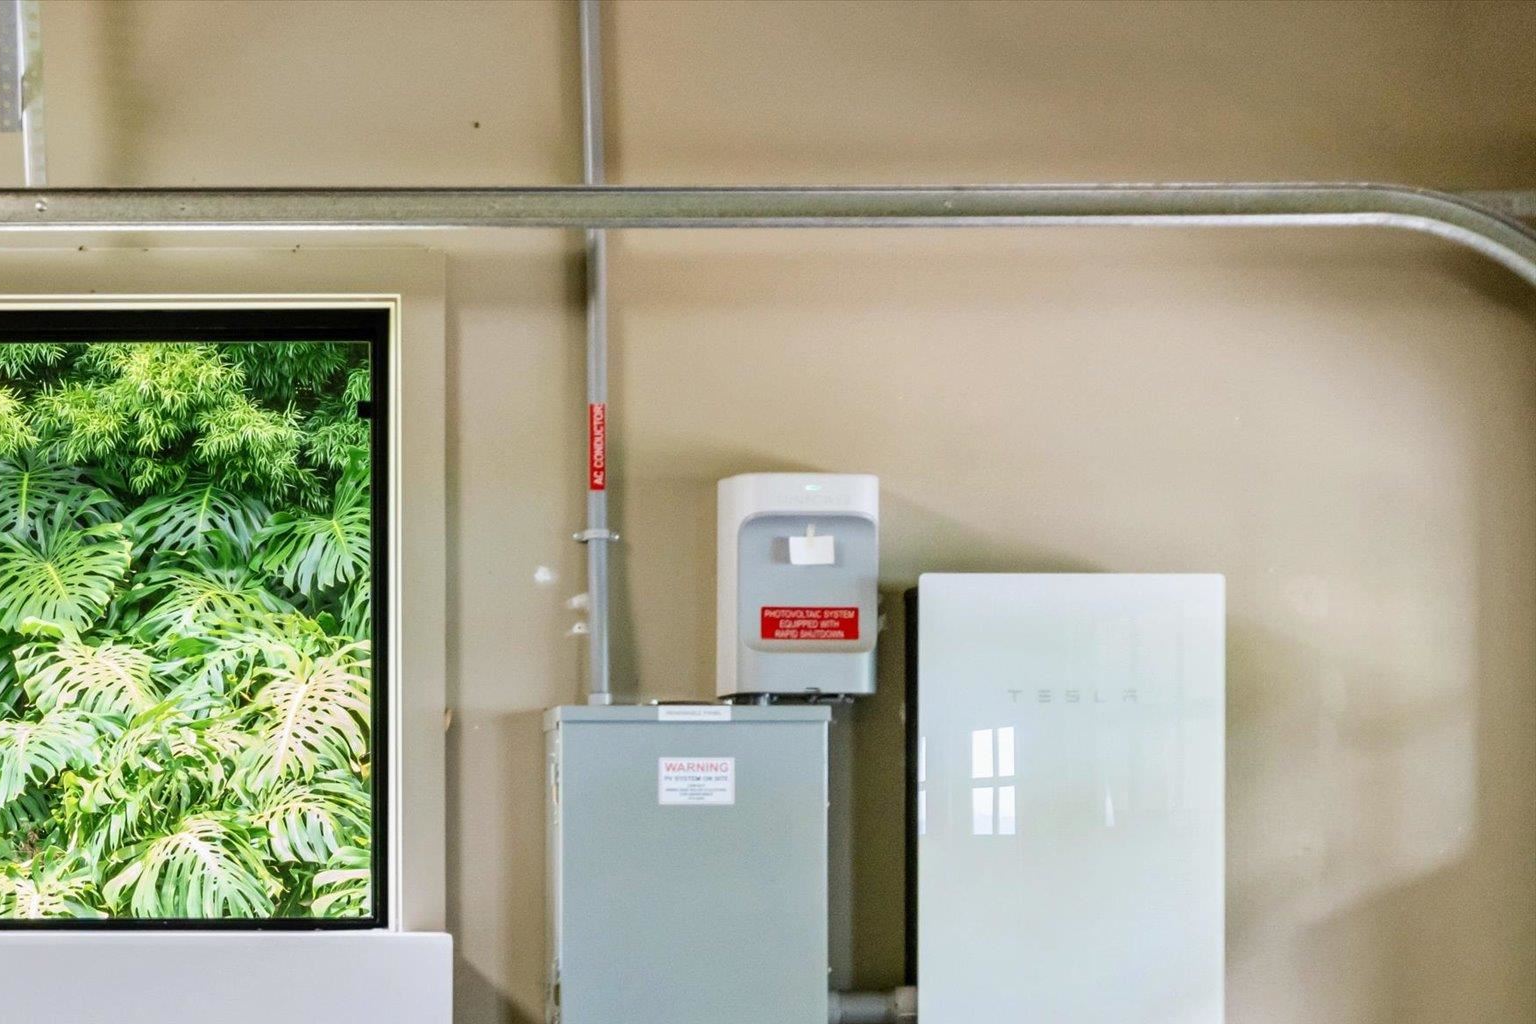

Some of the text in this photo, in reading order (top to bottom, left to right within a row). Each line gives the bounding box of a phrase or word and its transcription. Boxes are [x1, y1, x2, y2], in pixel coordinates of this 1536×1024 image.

[593, 470, 604, 485] AC
[823, 610, 855, 619] SYSTEM
[779, 619, 819, 629] EQUIPPED
[1007, 689, 1138, 703] TESLA
[665, 762, 729, 773] WARNING
